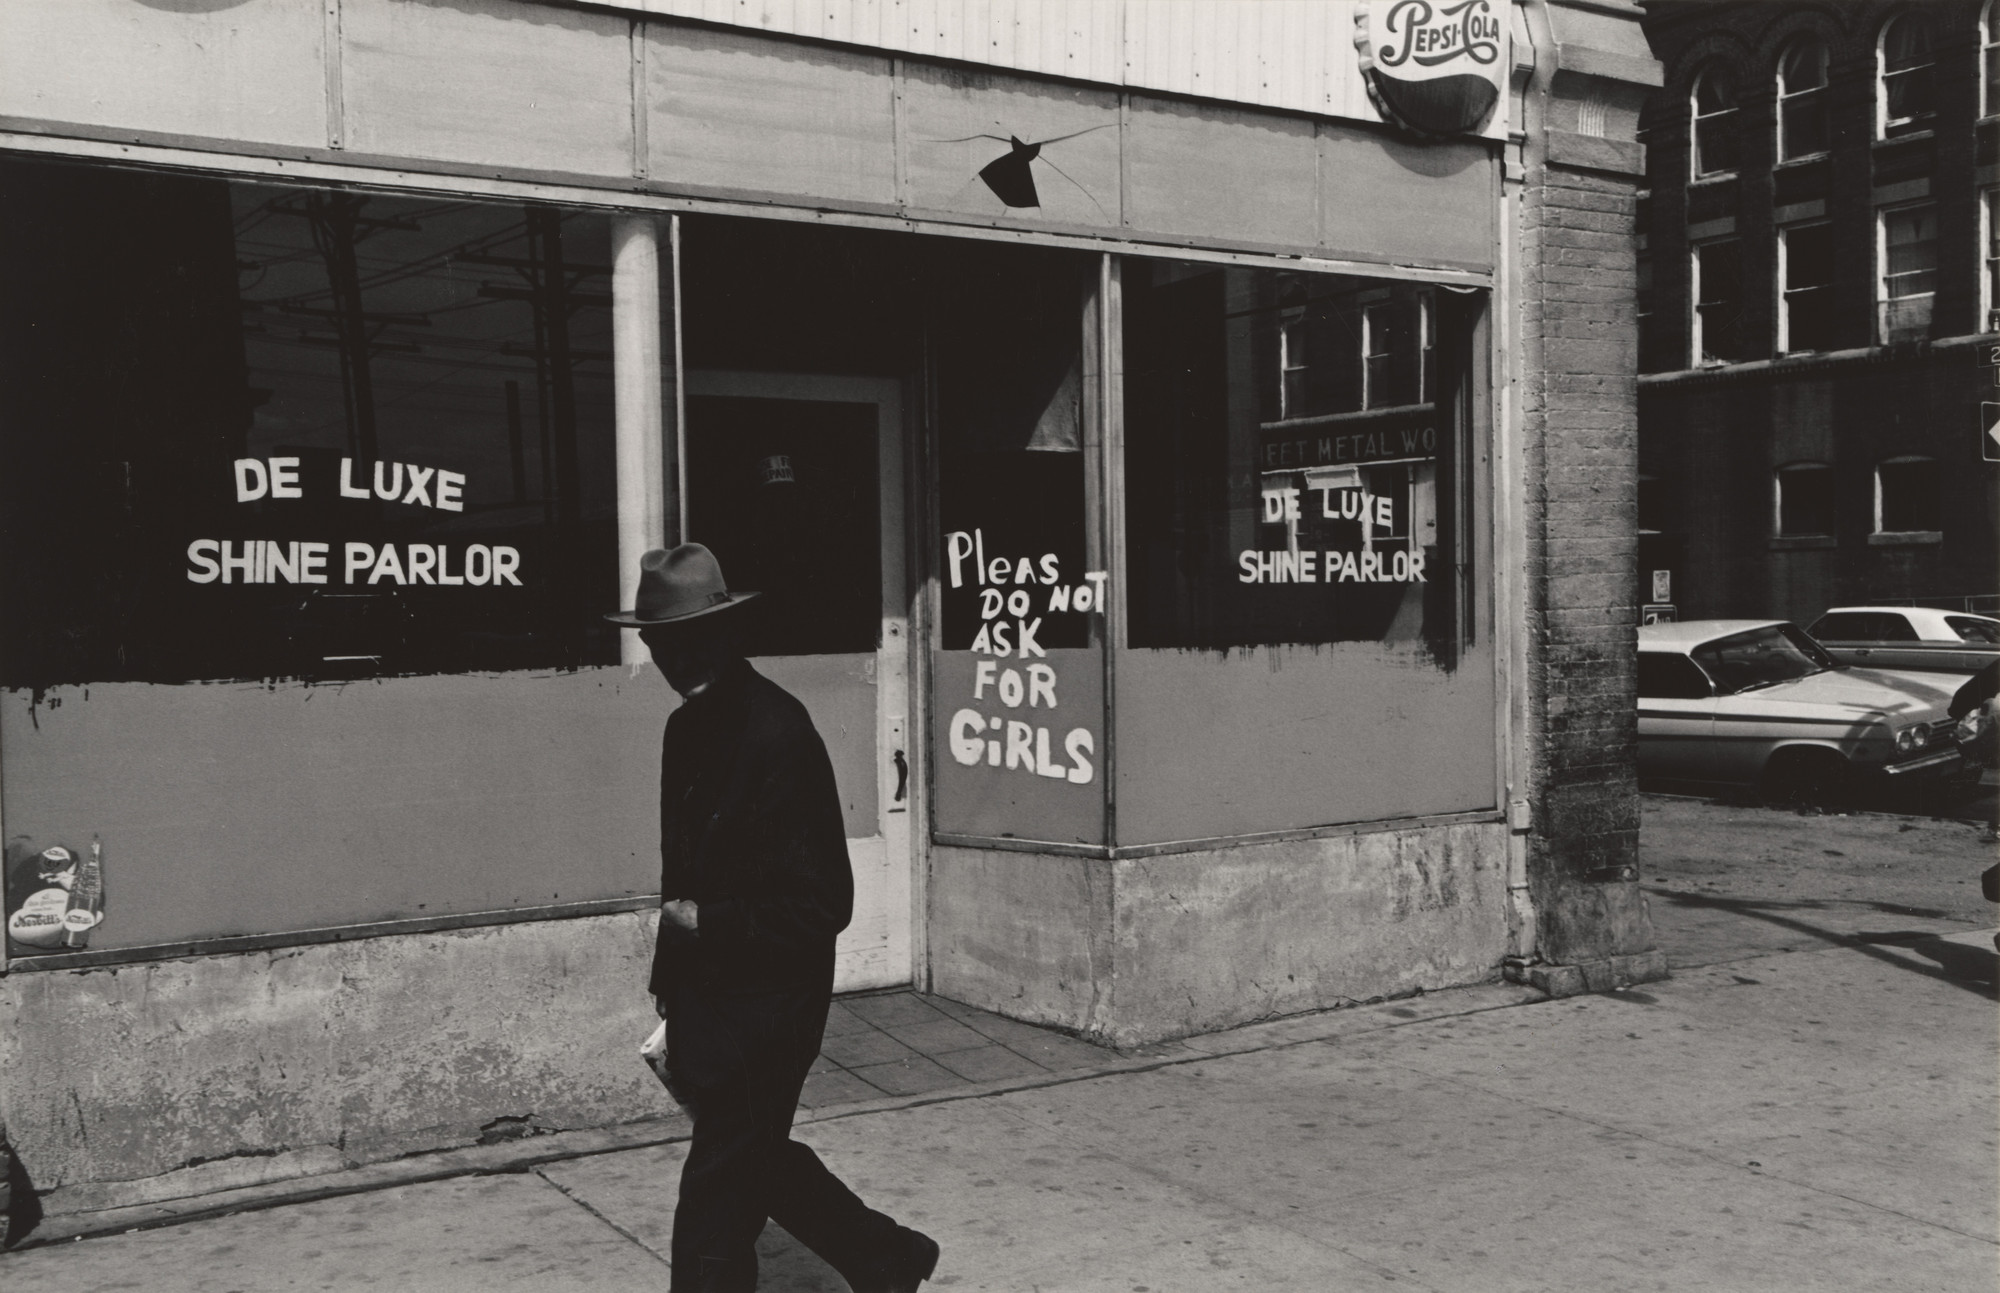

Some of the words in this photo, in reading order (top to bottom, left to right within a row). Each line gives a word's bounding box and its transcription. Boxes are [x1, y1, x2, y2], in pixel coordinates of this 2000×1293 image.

[1260, 440, 1308, 467] EET
[1317, 431, 1394, 462] METAL
[233, 456, 303, 502] DE
[340, 457, 466, 512] LUXE
[1263, 488, 1302, 523] DE
[1323, 487, 1393, 528] LUXE
[187, 538, 329, 584] SHINE
[345, 541, 524, 586] PARLOR
[1239, 549, 1317, 583] SHINE
[1325, 549, 1428, 583] PARLOR
[979, 587, 1030, 620] DO
[1048, 571, 1108, 613] NOT
[970, 617, 1047, 659] ASK
[974, 660, 1057, 708] FOR
